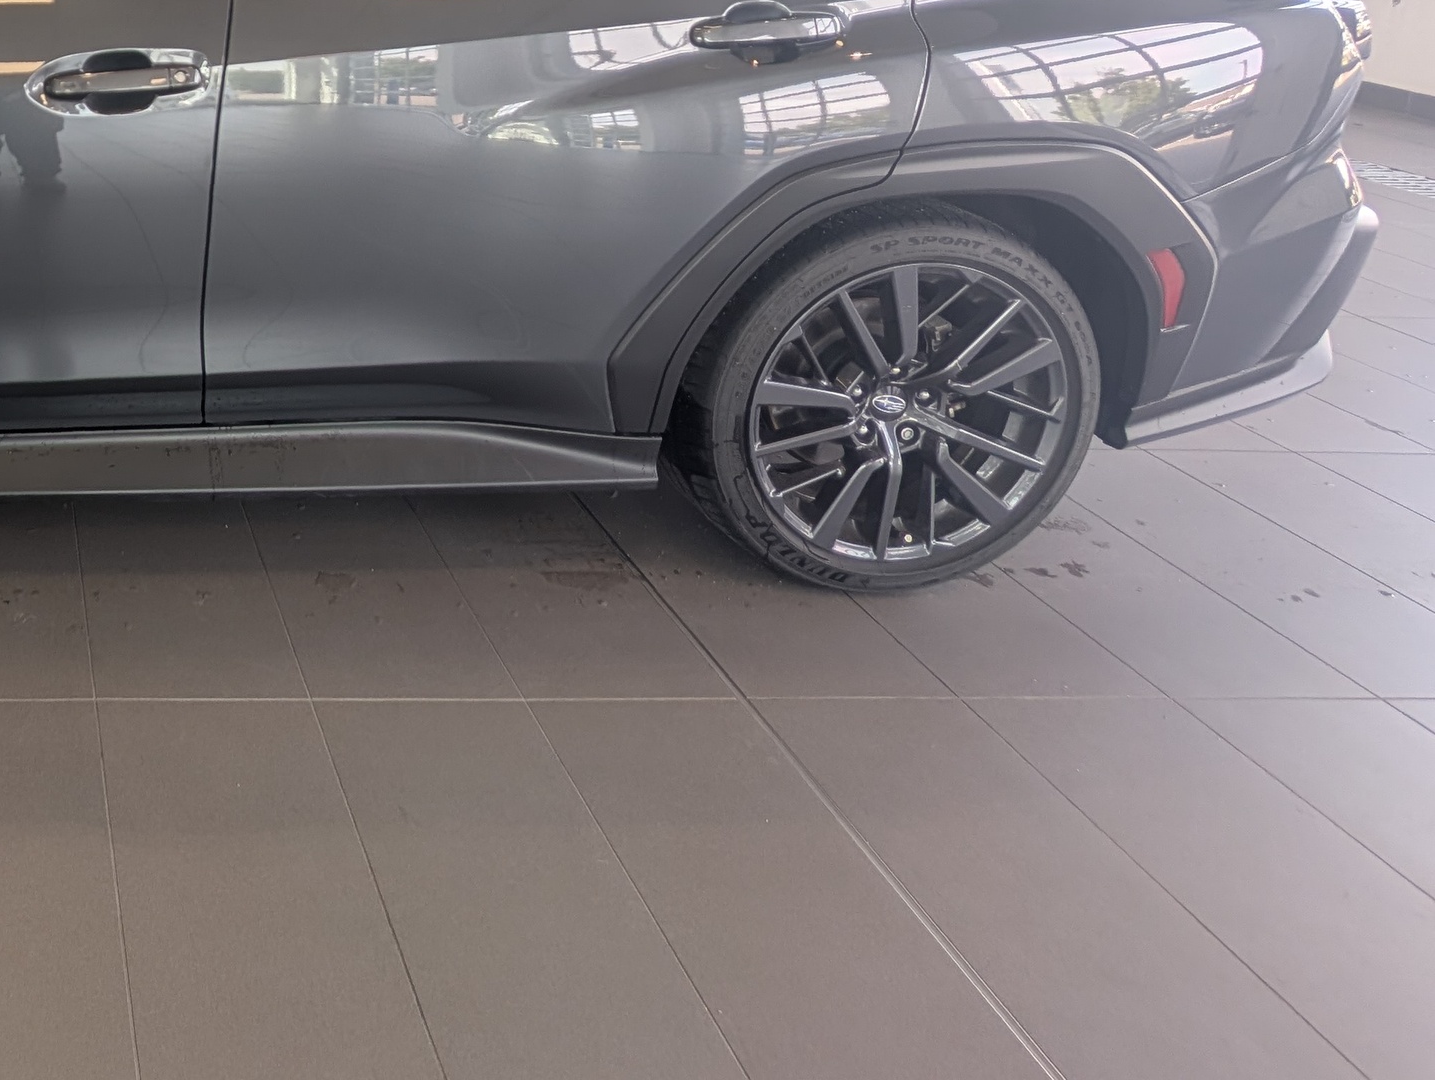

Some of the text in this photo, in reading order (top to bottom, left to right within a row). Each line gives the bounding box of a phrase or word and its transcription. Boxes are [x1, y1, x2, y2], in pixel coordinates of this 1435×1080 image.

[870, 239, 900, 254] SP
[908, 235, 986, 250] SPORT
[991, 247, 1054, 289] MAXX
